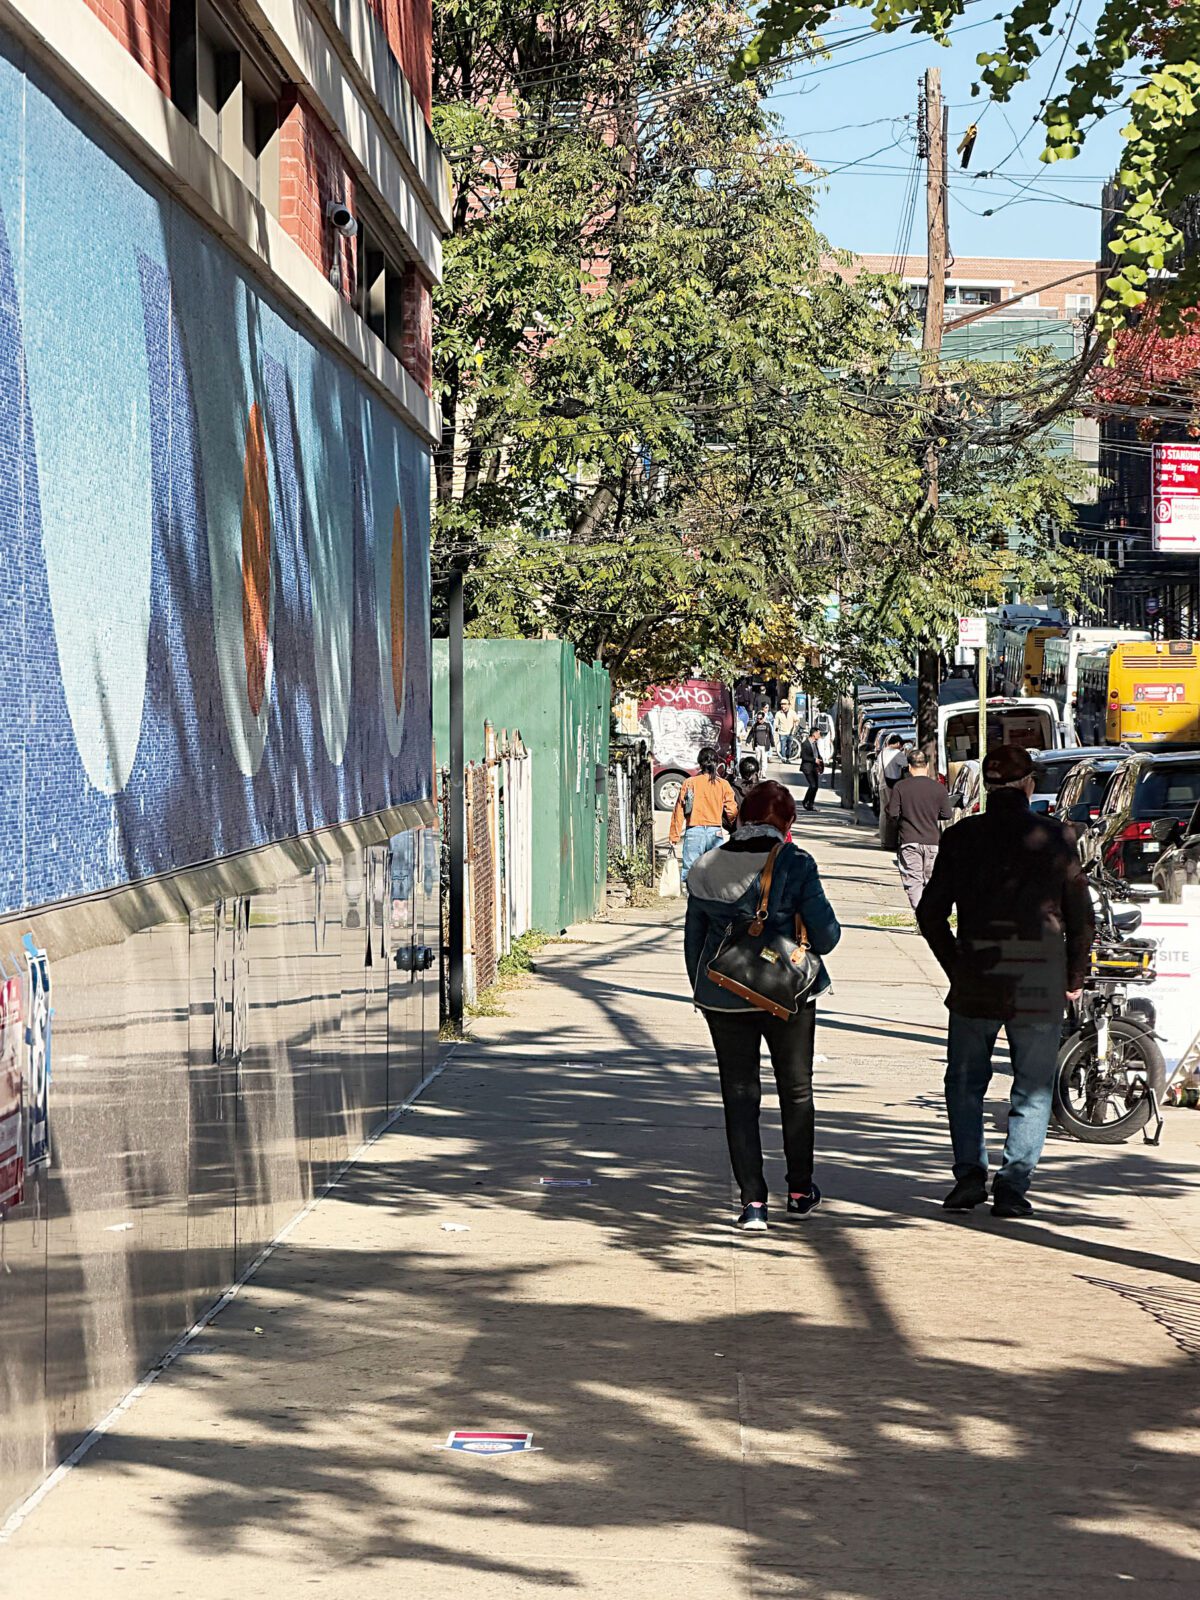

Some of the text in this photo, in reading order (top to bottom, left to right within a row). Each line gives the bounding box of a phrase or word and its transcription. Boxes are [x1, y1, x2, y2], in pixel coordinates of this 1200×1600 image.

[1156, 449, 1166, 459] NO
[1156, 462, 1177, 473] Monday
[1181, 463, 1199, 474] Friday
[1159, 951, 1190, 962] SITE
